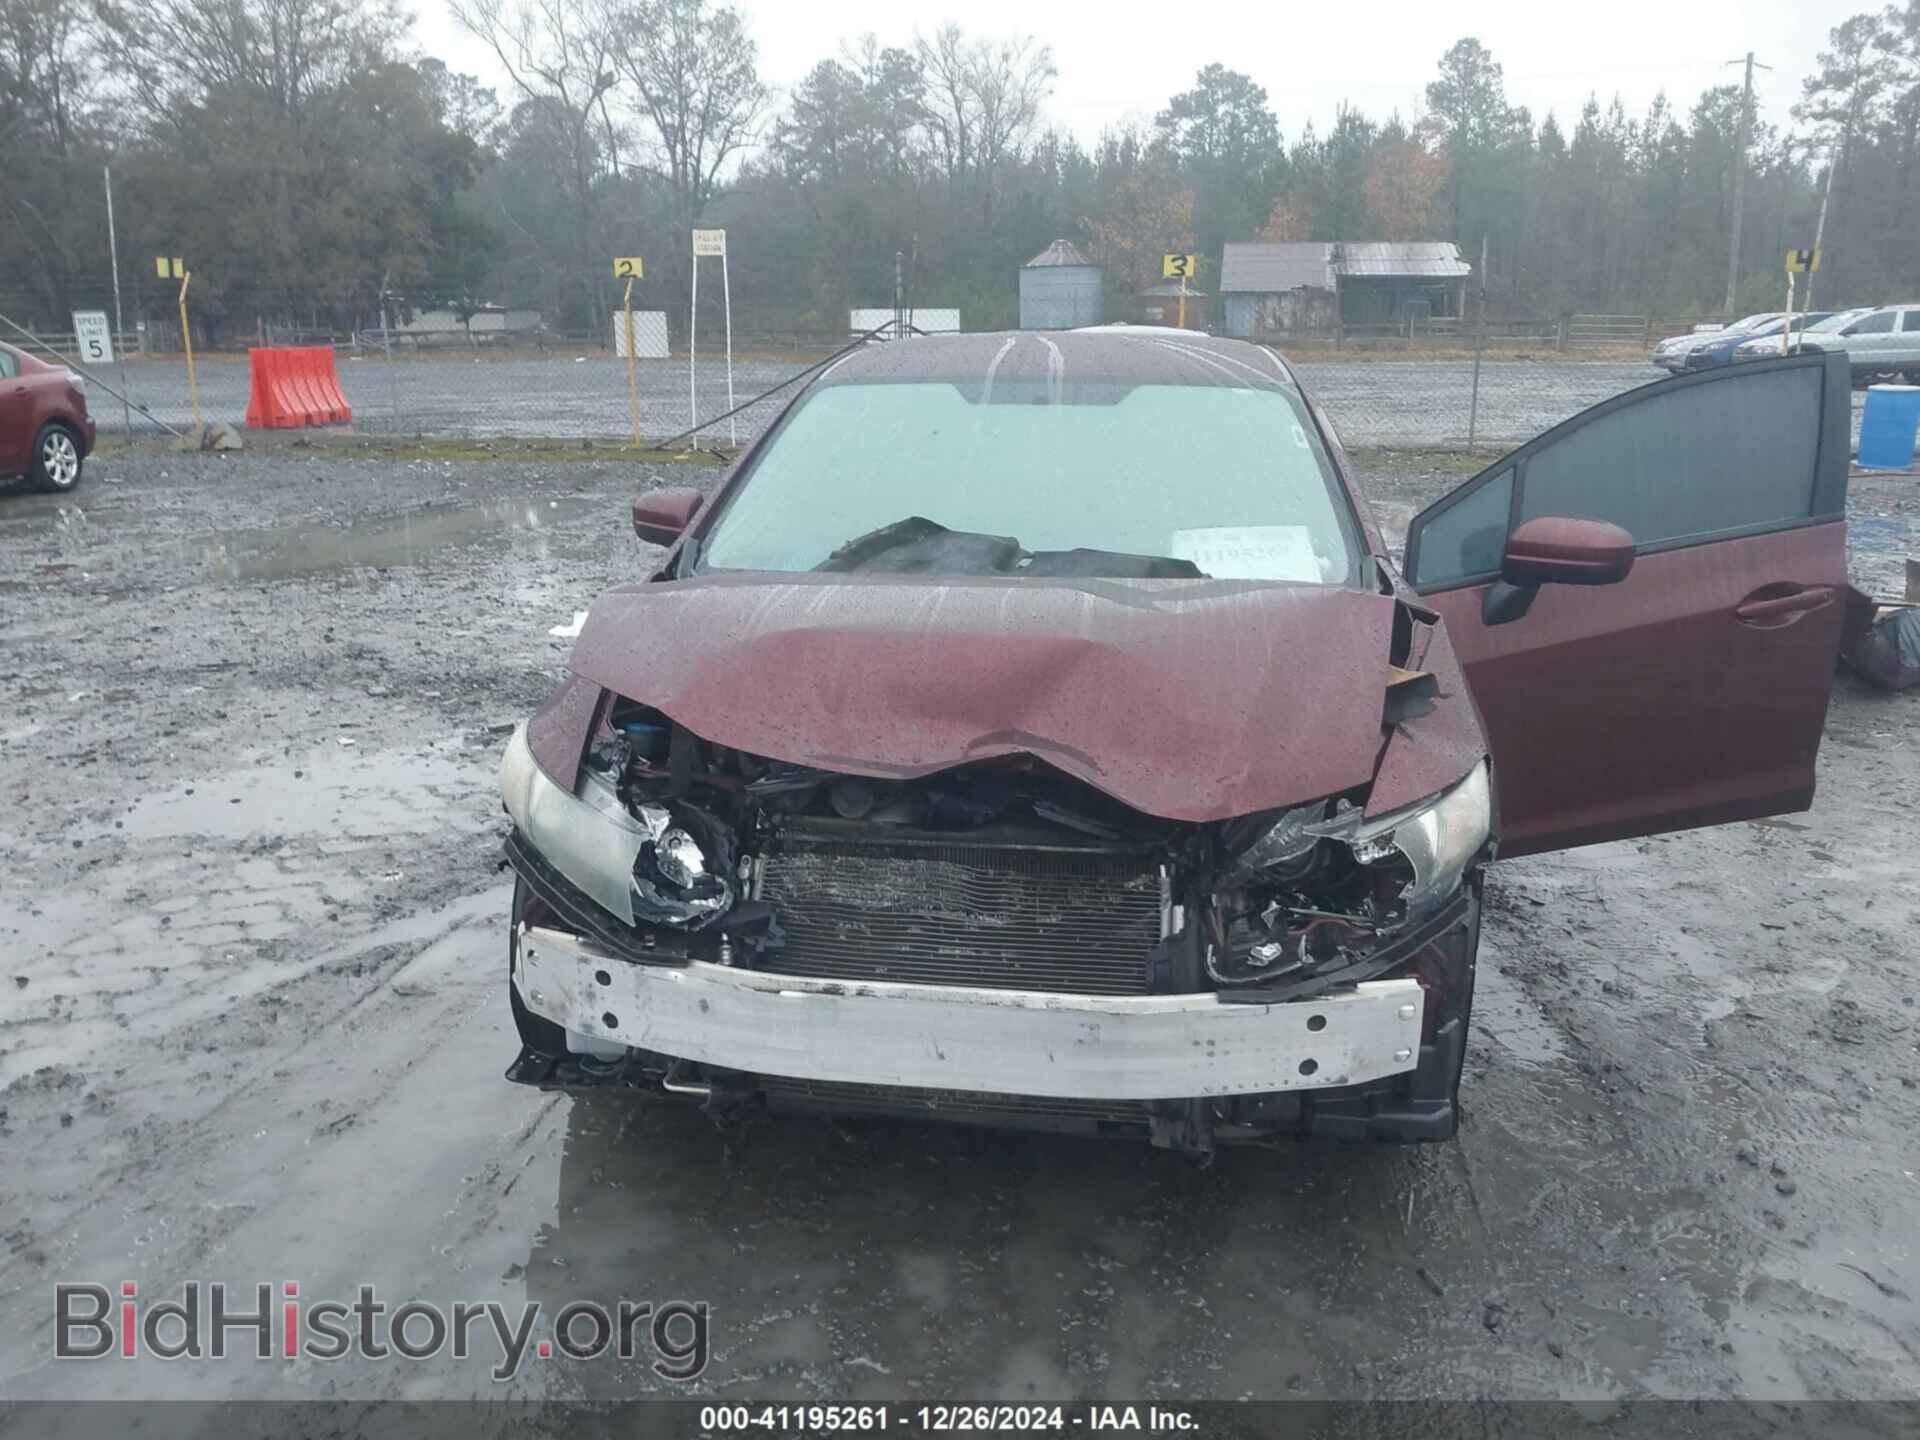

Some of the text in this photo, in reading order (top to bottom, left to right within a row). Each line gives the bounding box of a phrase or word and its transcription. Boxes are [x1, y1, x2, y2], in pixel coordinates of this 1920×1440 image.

[619, 260, 638, 278] 2
[1170, 256, 1188, 277] 3
[1795, 250, 1814, 272] 4
[77, 316, 105, 326] SPEED
[89, 340, 104, 358] 5
